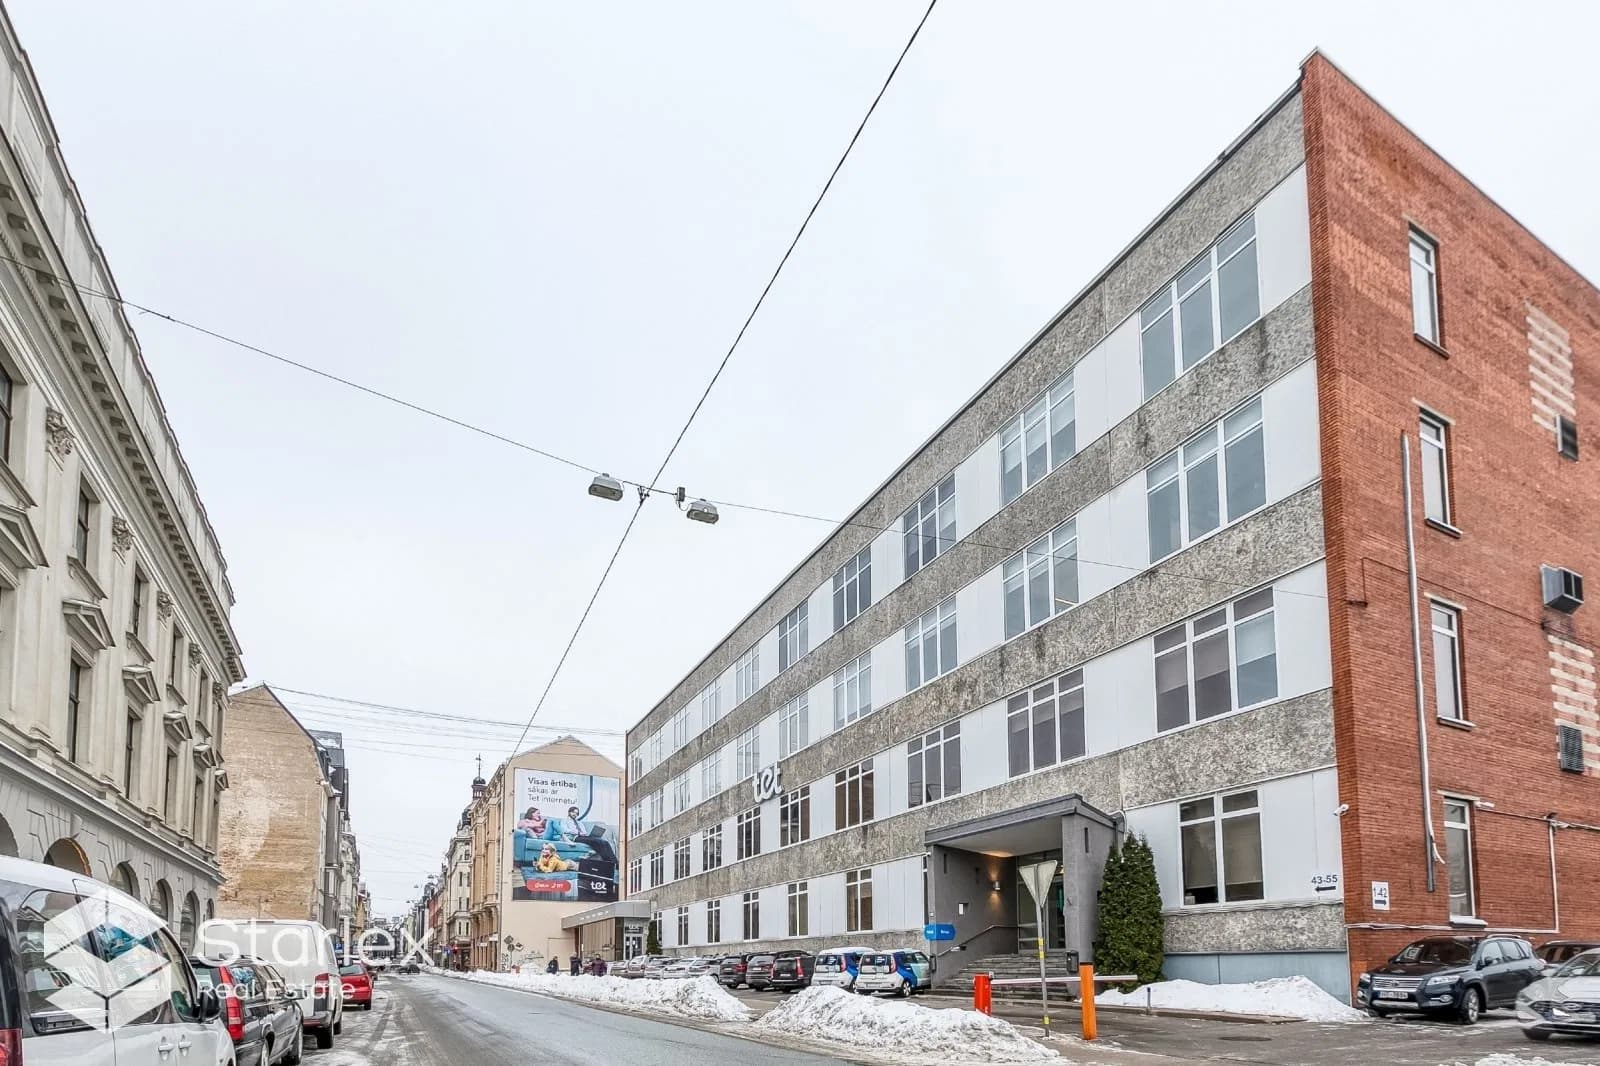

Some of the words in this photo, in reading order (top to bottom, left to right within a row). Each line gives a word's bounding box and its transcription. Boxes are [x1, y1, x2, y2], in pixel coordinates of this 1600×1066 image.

[528, 777, 549, 785] Visas
[752, 762, 782, 802] tet
[1311, 875, 1338, 884] 43-55
[590, 881, 607, 890] tet
